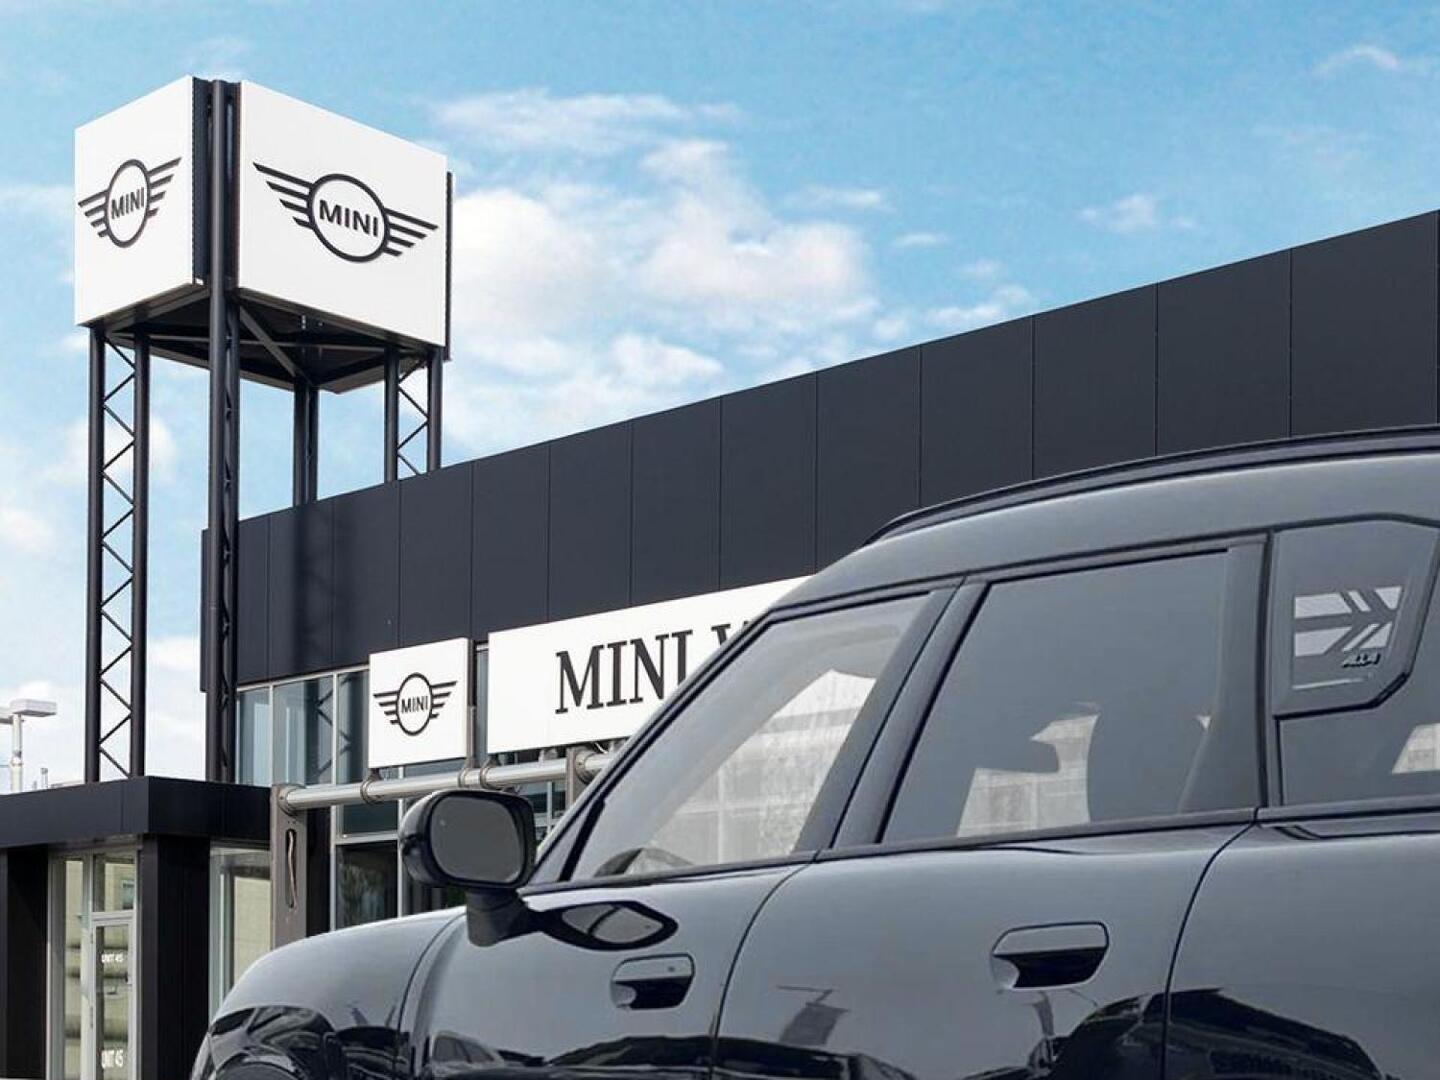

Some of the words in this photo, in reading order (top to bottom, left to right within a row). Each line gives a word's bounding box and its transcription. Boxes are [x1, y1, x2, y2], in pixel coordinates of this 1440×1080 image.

[111, 187, 145, 220] MINI
[318, 198, 379, 237] MINI
[555, 628, 693, 714] MINI
[401, 695, 429, 714] MINI
